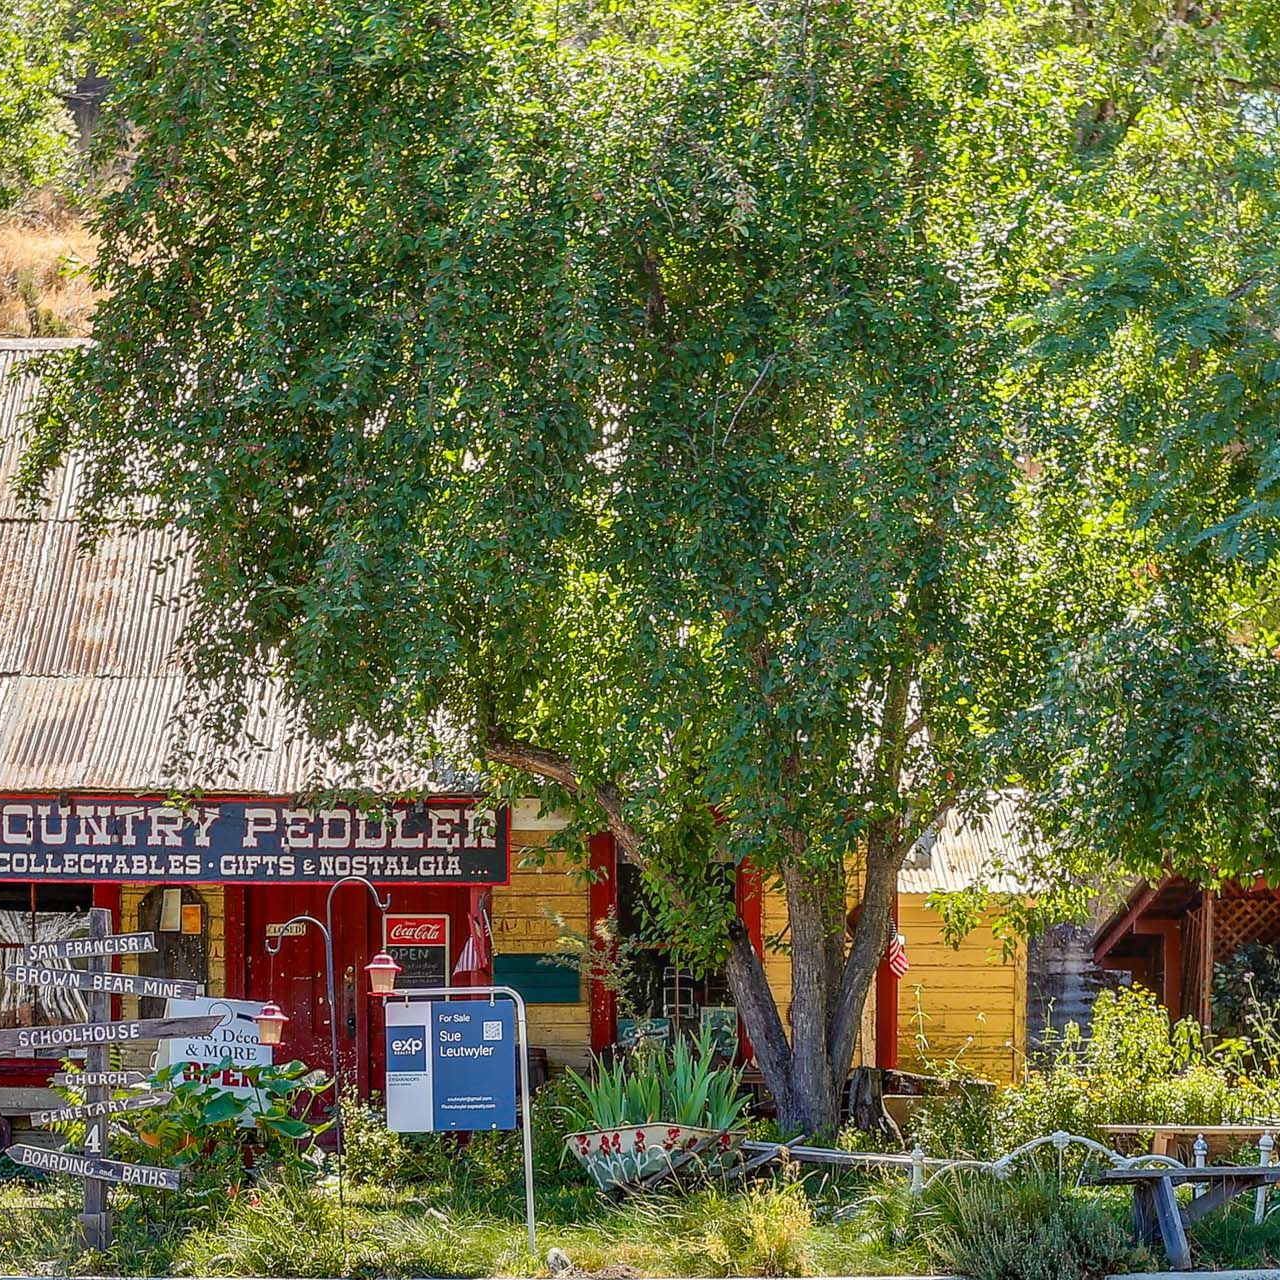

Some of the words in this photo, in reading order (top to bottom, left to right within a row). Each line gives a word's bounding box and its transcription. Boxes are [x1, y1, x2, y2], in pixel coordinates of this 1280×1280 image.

[242, 808, 496, 849] PEDDLER
[220, 855, 295, 876] GIFTS
[303, 858, 315, 875] &
[320, 856, 461, 876] NOSTALGIA
[391, 924, 440, 940] Coca-Cola
[29, 944, 58, 960] SAN
[390, 948, 429, 960] OPEN
[15, 968, 81, 987] BROWN
[93, 974, 134, 993] BEAR
[144, 981, 182, 998] MINE
[439, 1014, 451, 1022] For
[453, 1013, 470, 1022] Sale
[18, 1024, 140, 1047] SCHOOLHOUSE
[439, 1031, 461, 1042] Sue
[186, 1043, 199, 1056] &
[204, 1045, 257, 1060] MORE
[440, 1045, 494, 1059] Leutwyler
[65, 1074, 128, 1085] CHURCH
[41, 1099, 129, 1123] CEMETARY
[84, 1124, 101, 1153] 4
[122, 1166, 167, 1186] BATHS
